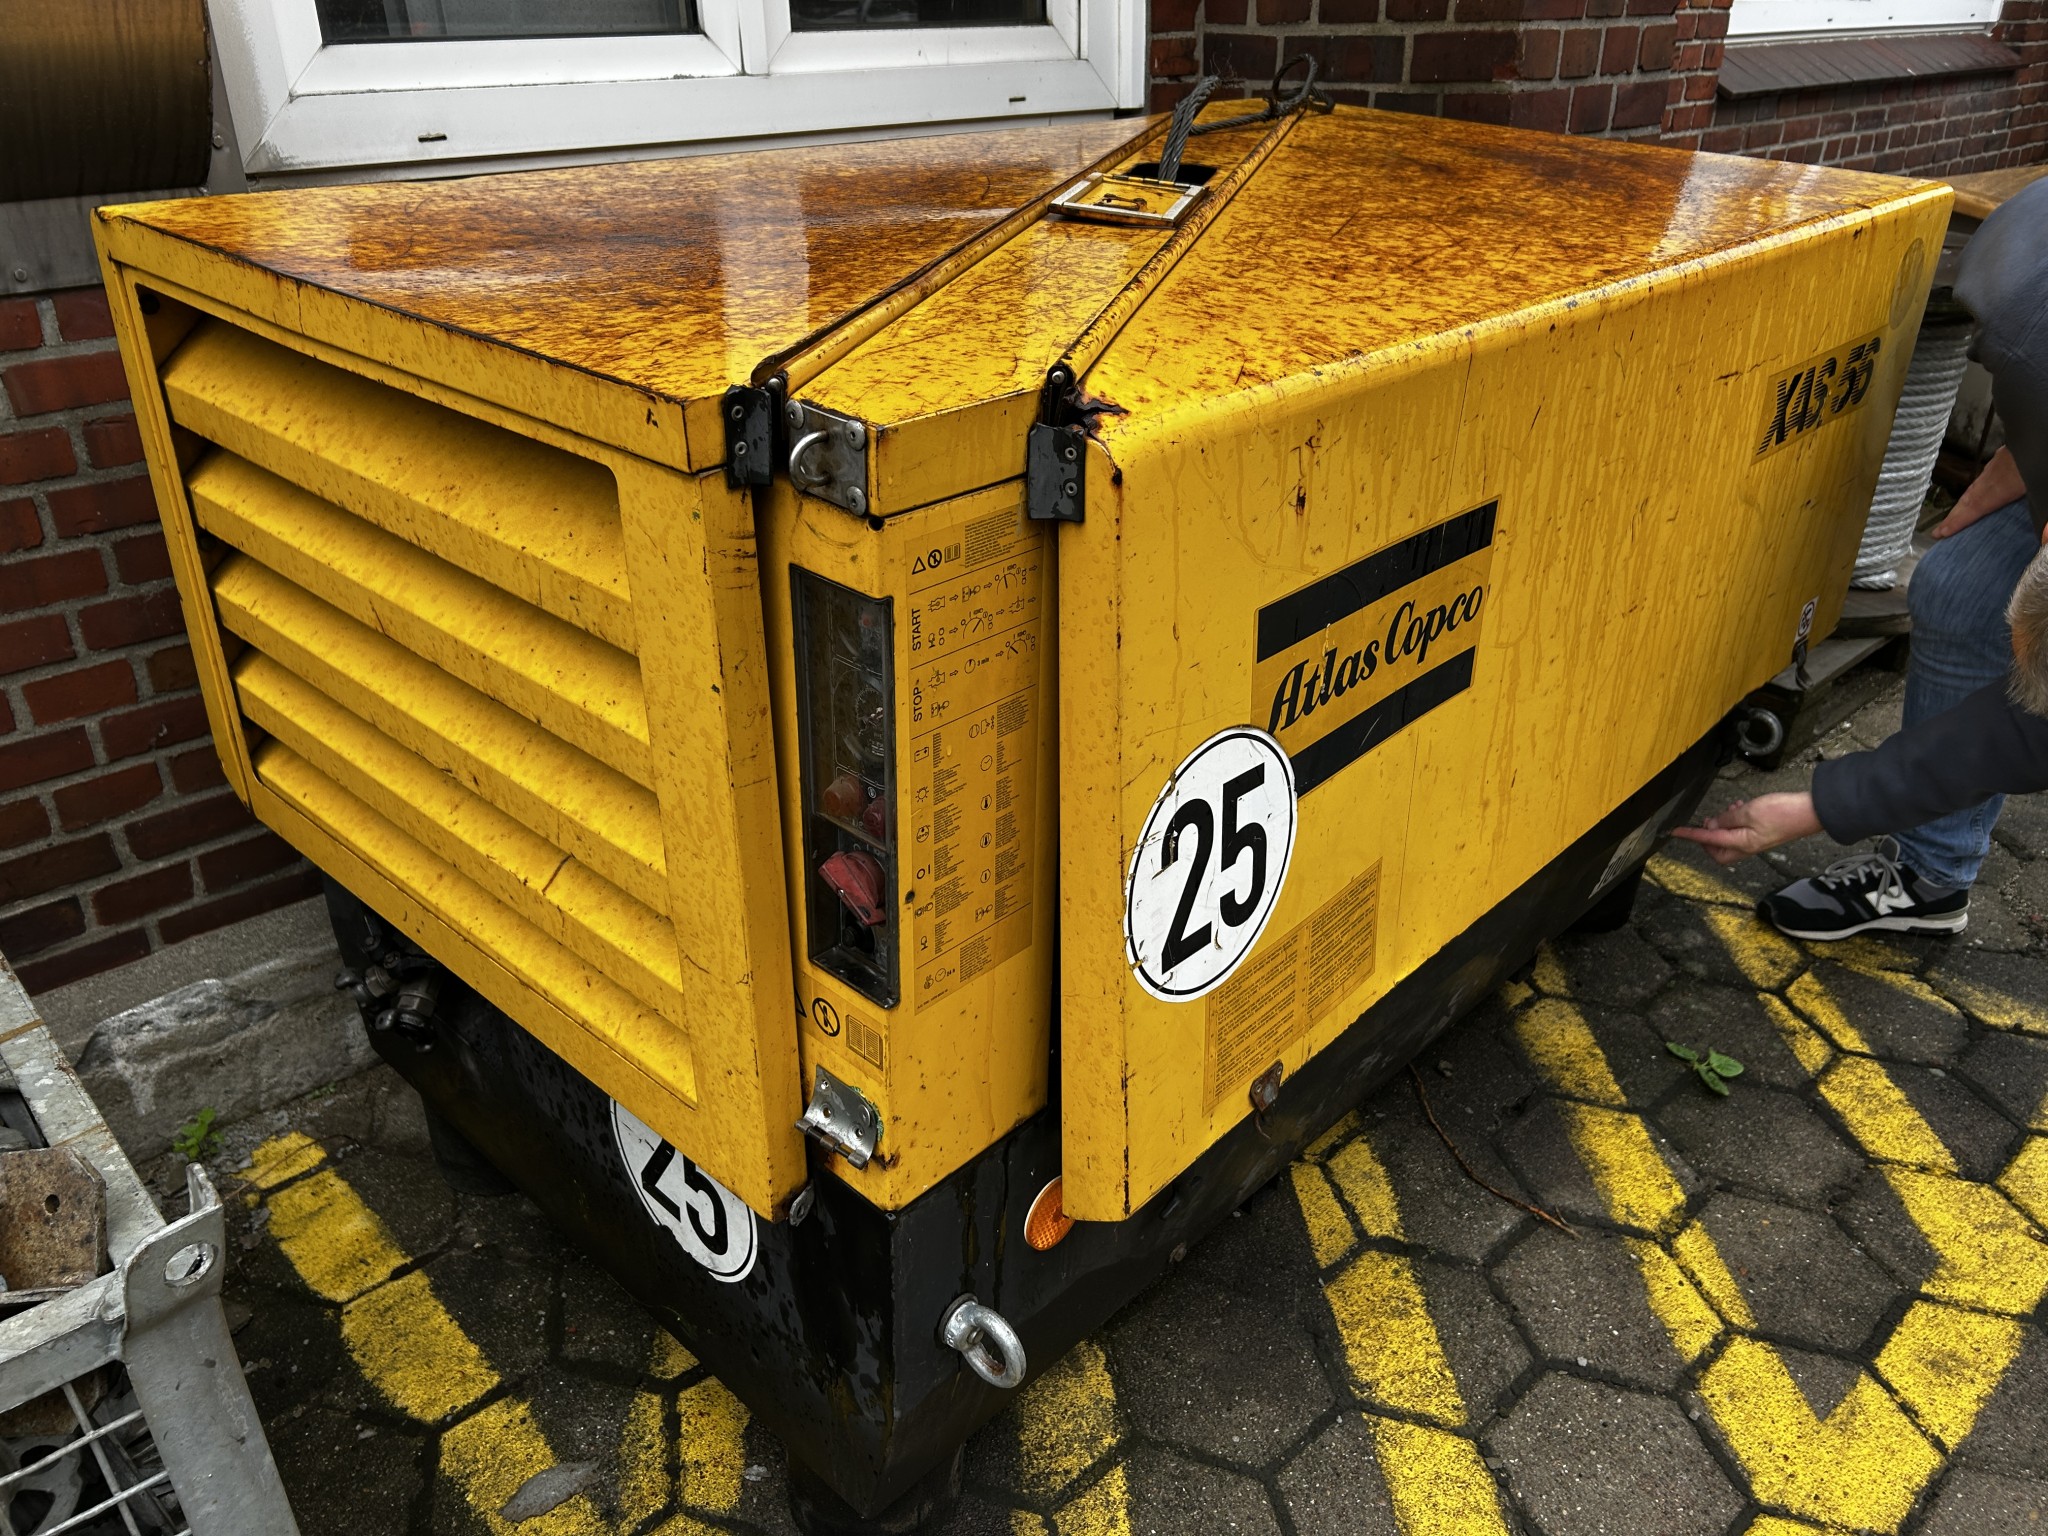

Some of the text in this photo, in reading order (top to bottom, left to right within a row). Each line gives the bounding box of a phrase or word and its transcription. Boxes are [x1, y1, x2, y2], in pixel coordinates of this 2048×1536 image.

[1756, 357, 1837, 456] XAS
[911, 608, 922, 652] START
[1266, 584, 1484, 736] Atlas Copco
[912, 686, 923, 723] STOP
[1160, 761, 1268, 976] 25
